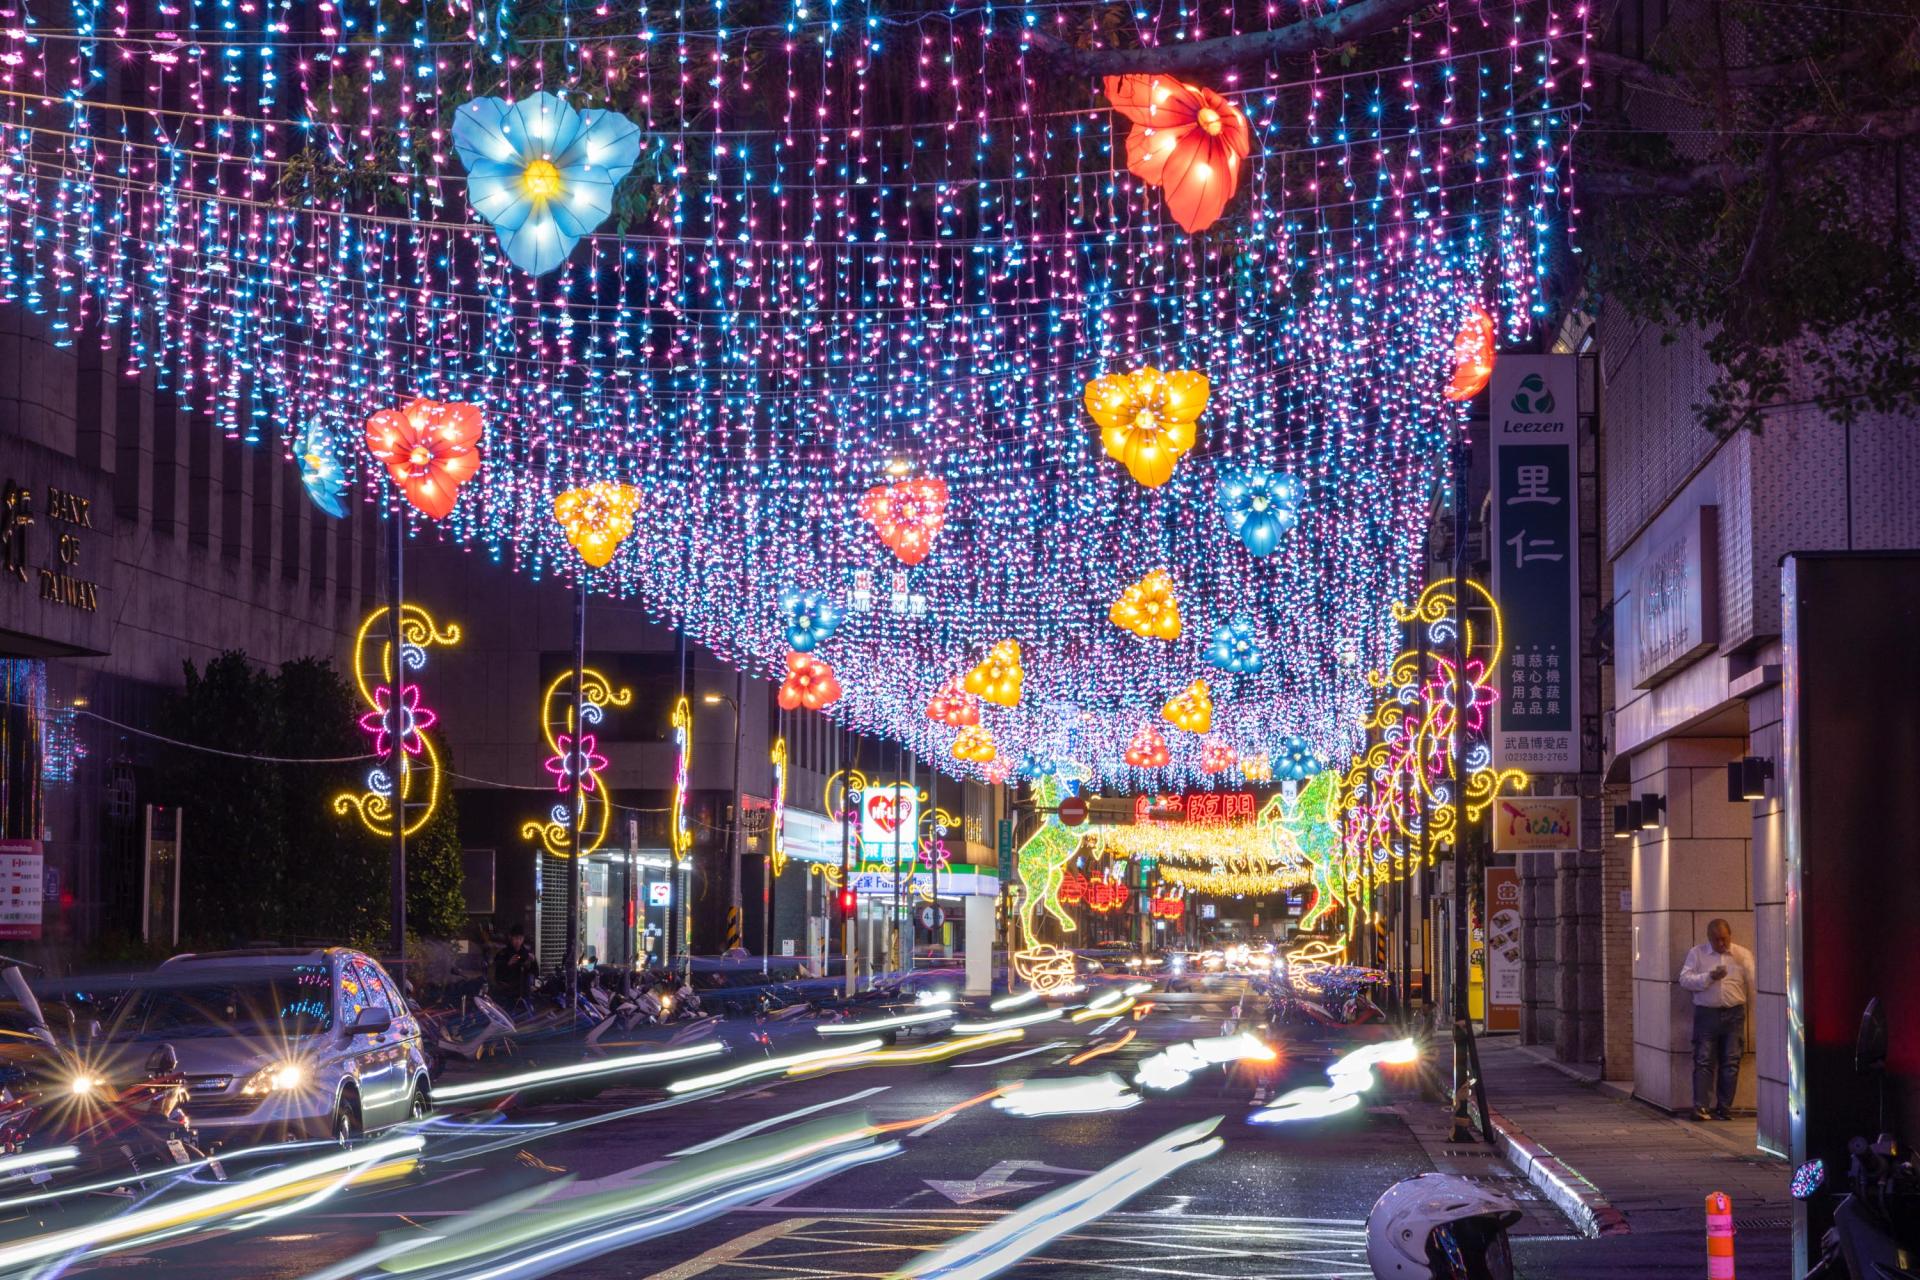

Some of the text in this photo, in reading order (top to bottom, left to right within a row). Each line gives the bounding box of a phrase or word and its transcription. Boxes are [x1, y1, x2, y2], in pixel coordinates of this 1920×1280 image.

[1503, 420, 1564, 433] Leezen
[48, 486, 92, 529] BANK
[1506, 465, 1563, 568] 里仁
[60, 534, 81, 566] OF
[40, 568, 98, 613] TAIWAN
[1511, 654, 1525, 715] 環保用品
[1529, 654, 1542, 715] 慈心食品
[1546, 654, 1560, 715] 有機蔬果
[1505, 736, 1568, 750] 武昌博愛店
